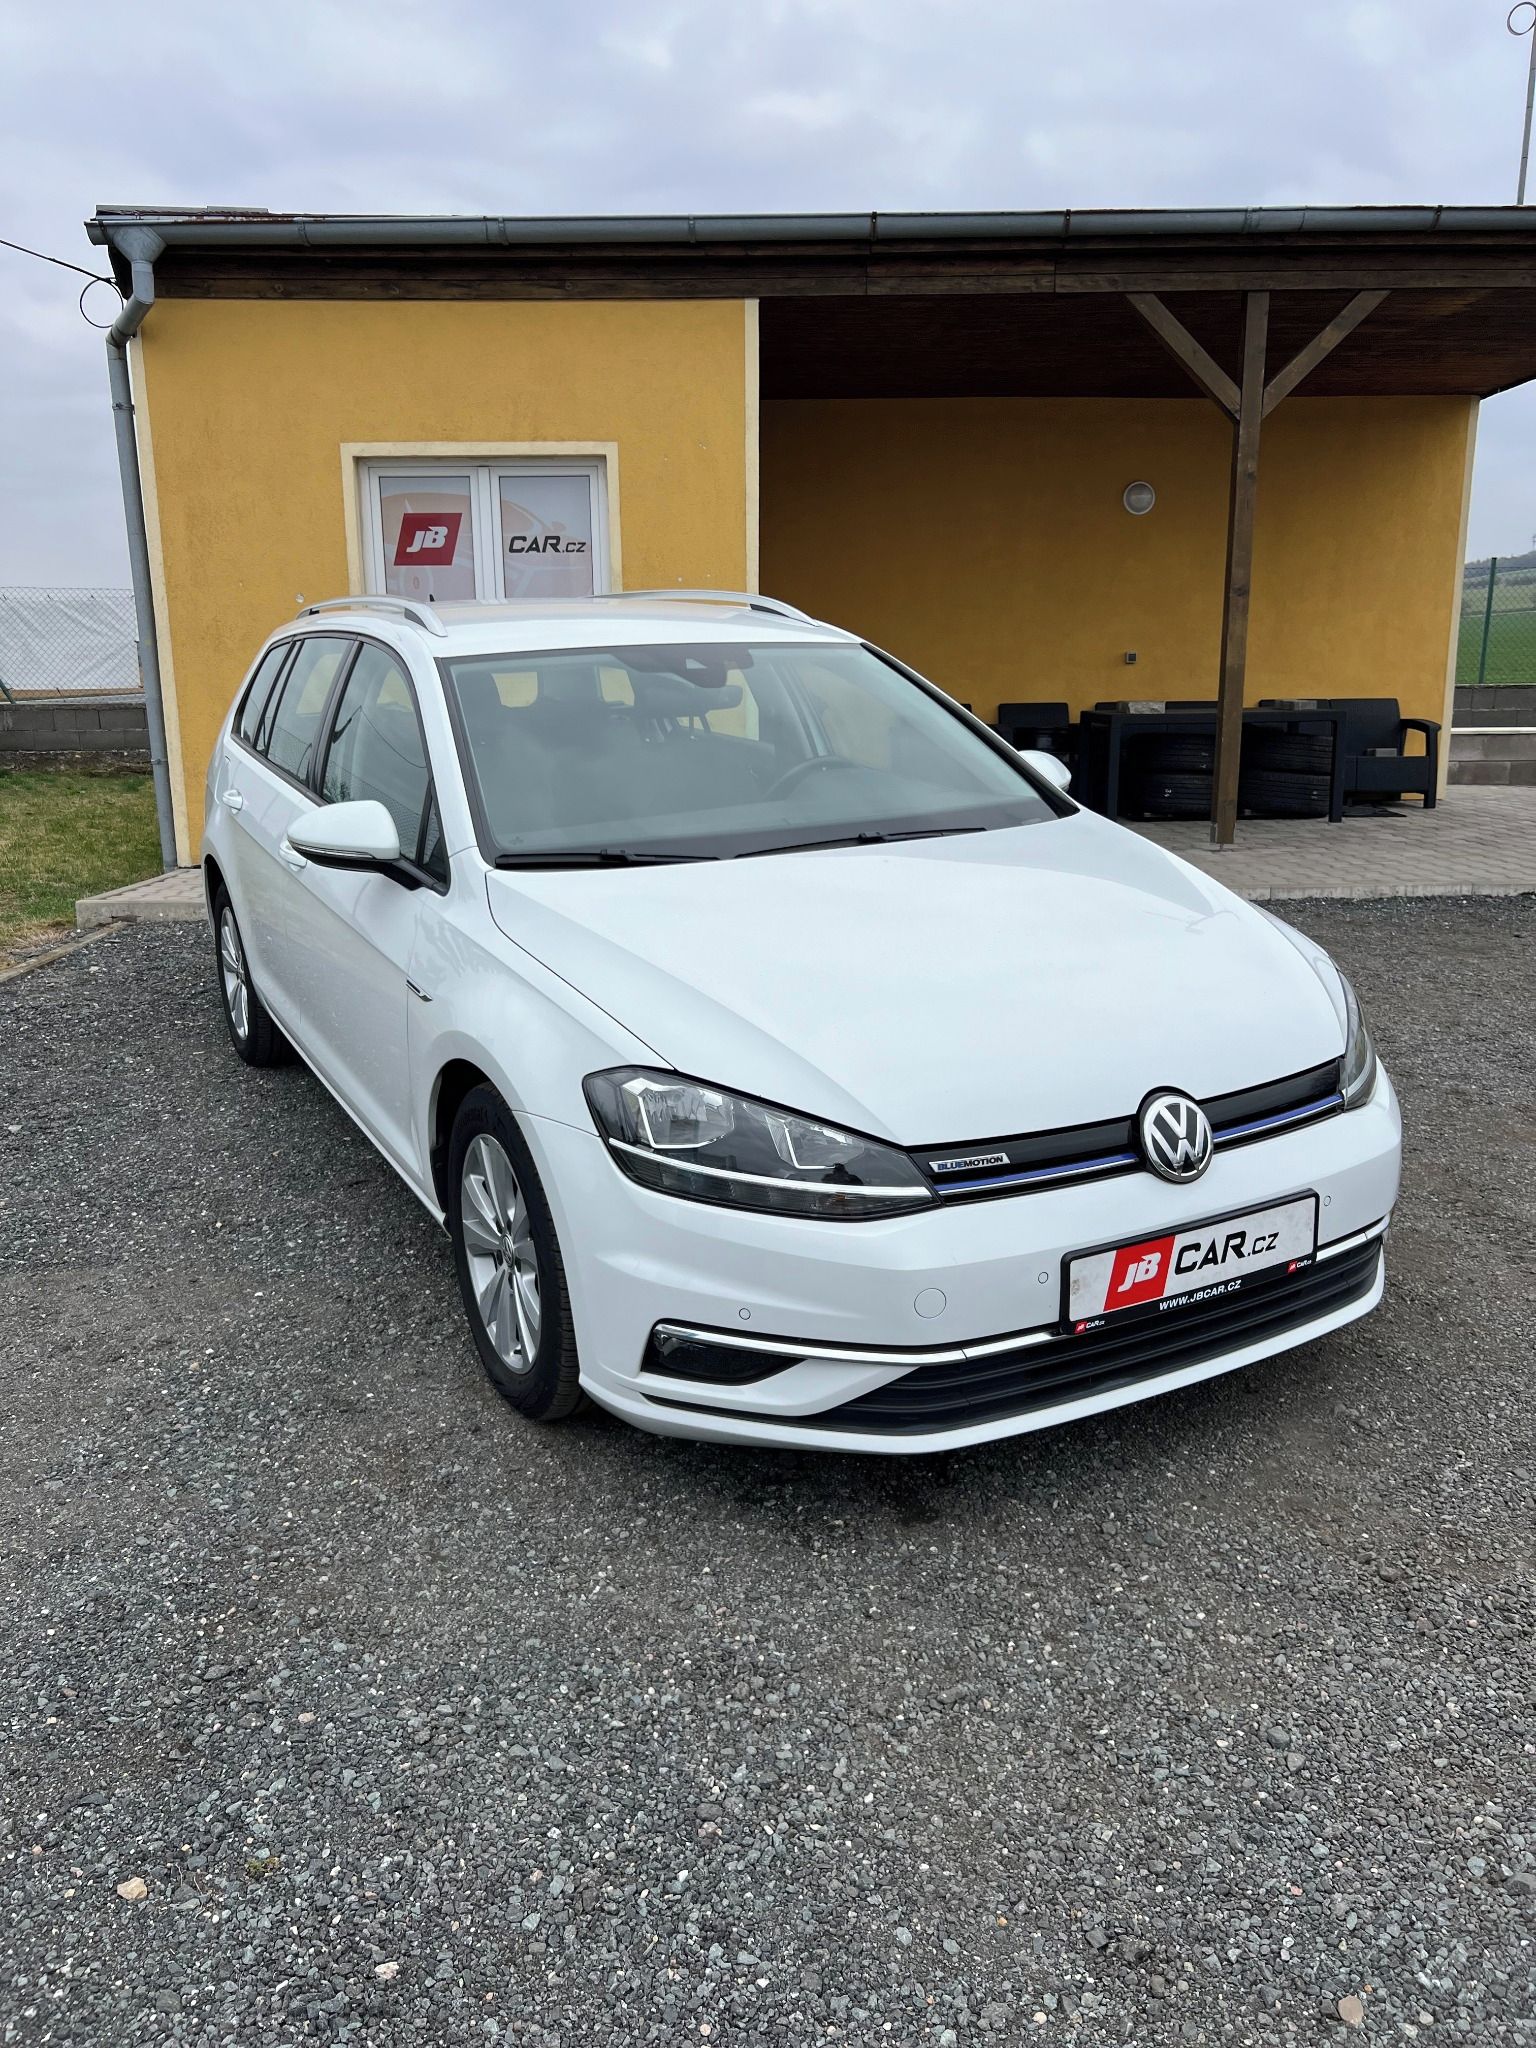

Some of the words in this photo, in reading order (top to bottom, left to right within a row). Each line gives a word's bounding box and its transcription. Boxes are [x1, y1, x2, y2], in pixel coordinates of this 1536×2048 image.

[406, 526, 449, 553] JB
[1149, 1102, 1208, 1174] VW
[937, 1154, 1004, 1172] BLUEMOTION
[1117, 1252, 1162, 1293] JB
[1159, 1279, 1242, 1311] WWW.JBCAR.CZ
